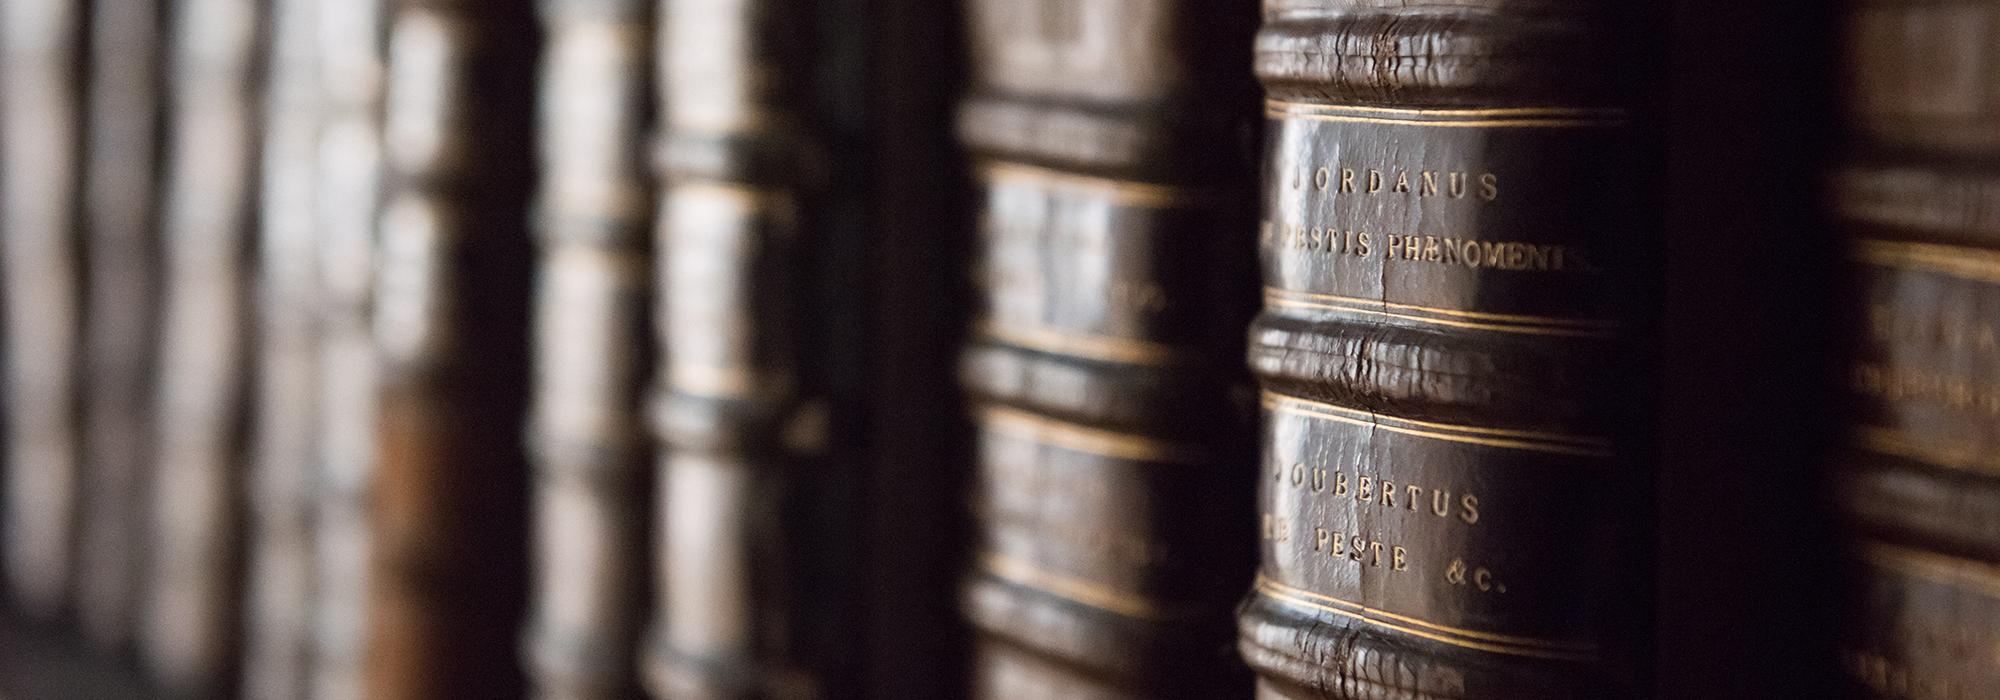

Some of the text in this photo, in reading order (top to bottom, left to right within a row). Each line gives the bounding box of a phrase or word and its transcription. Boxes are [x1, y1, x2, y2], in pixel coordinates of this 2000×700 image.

[1292, 166, 1498, 201] JORDANUS
[1388, 235, 1584, 270] PHÆNOMENI
[1315, 527, 1409, 573] PESTE
